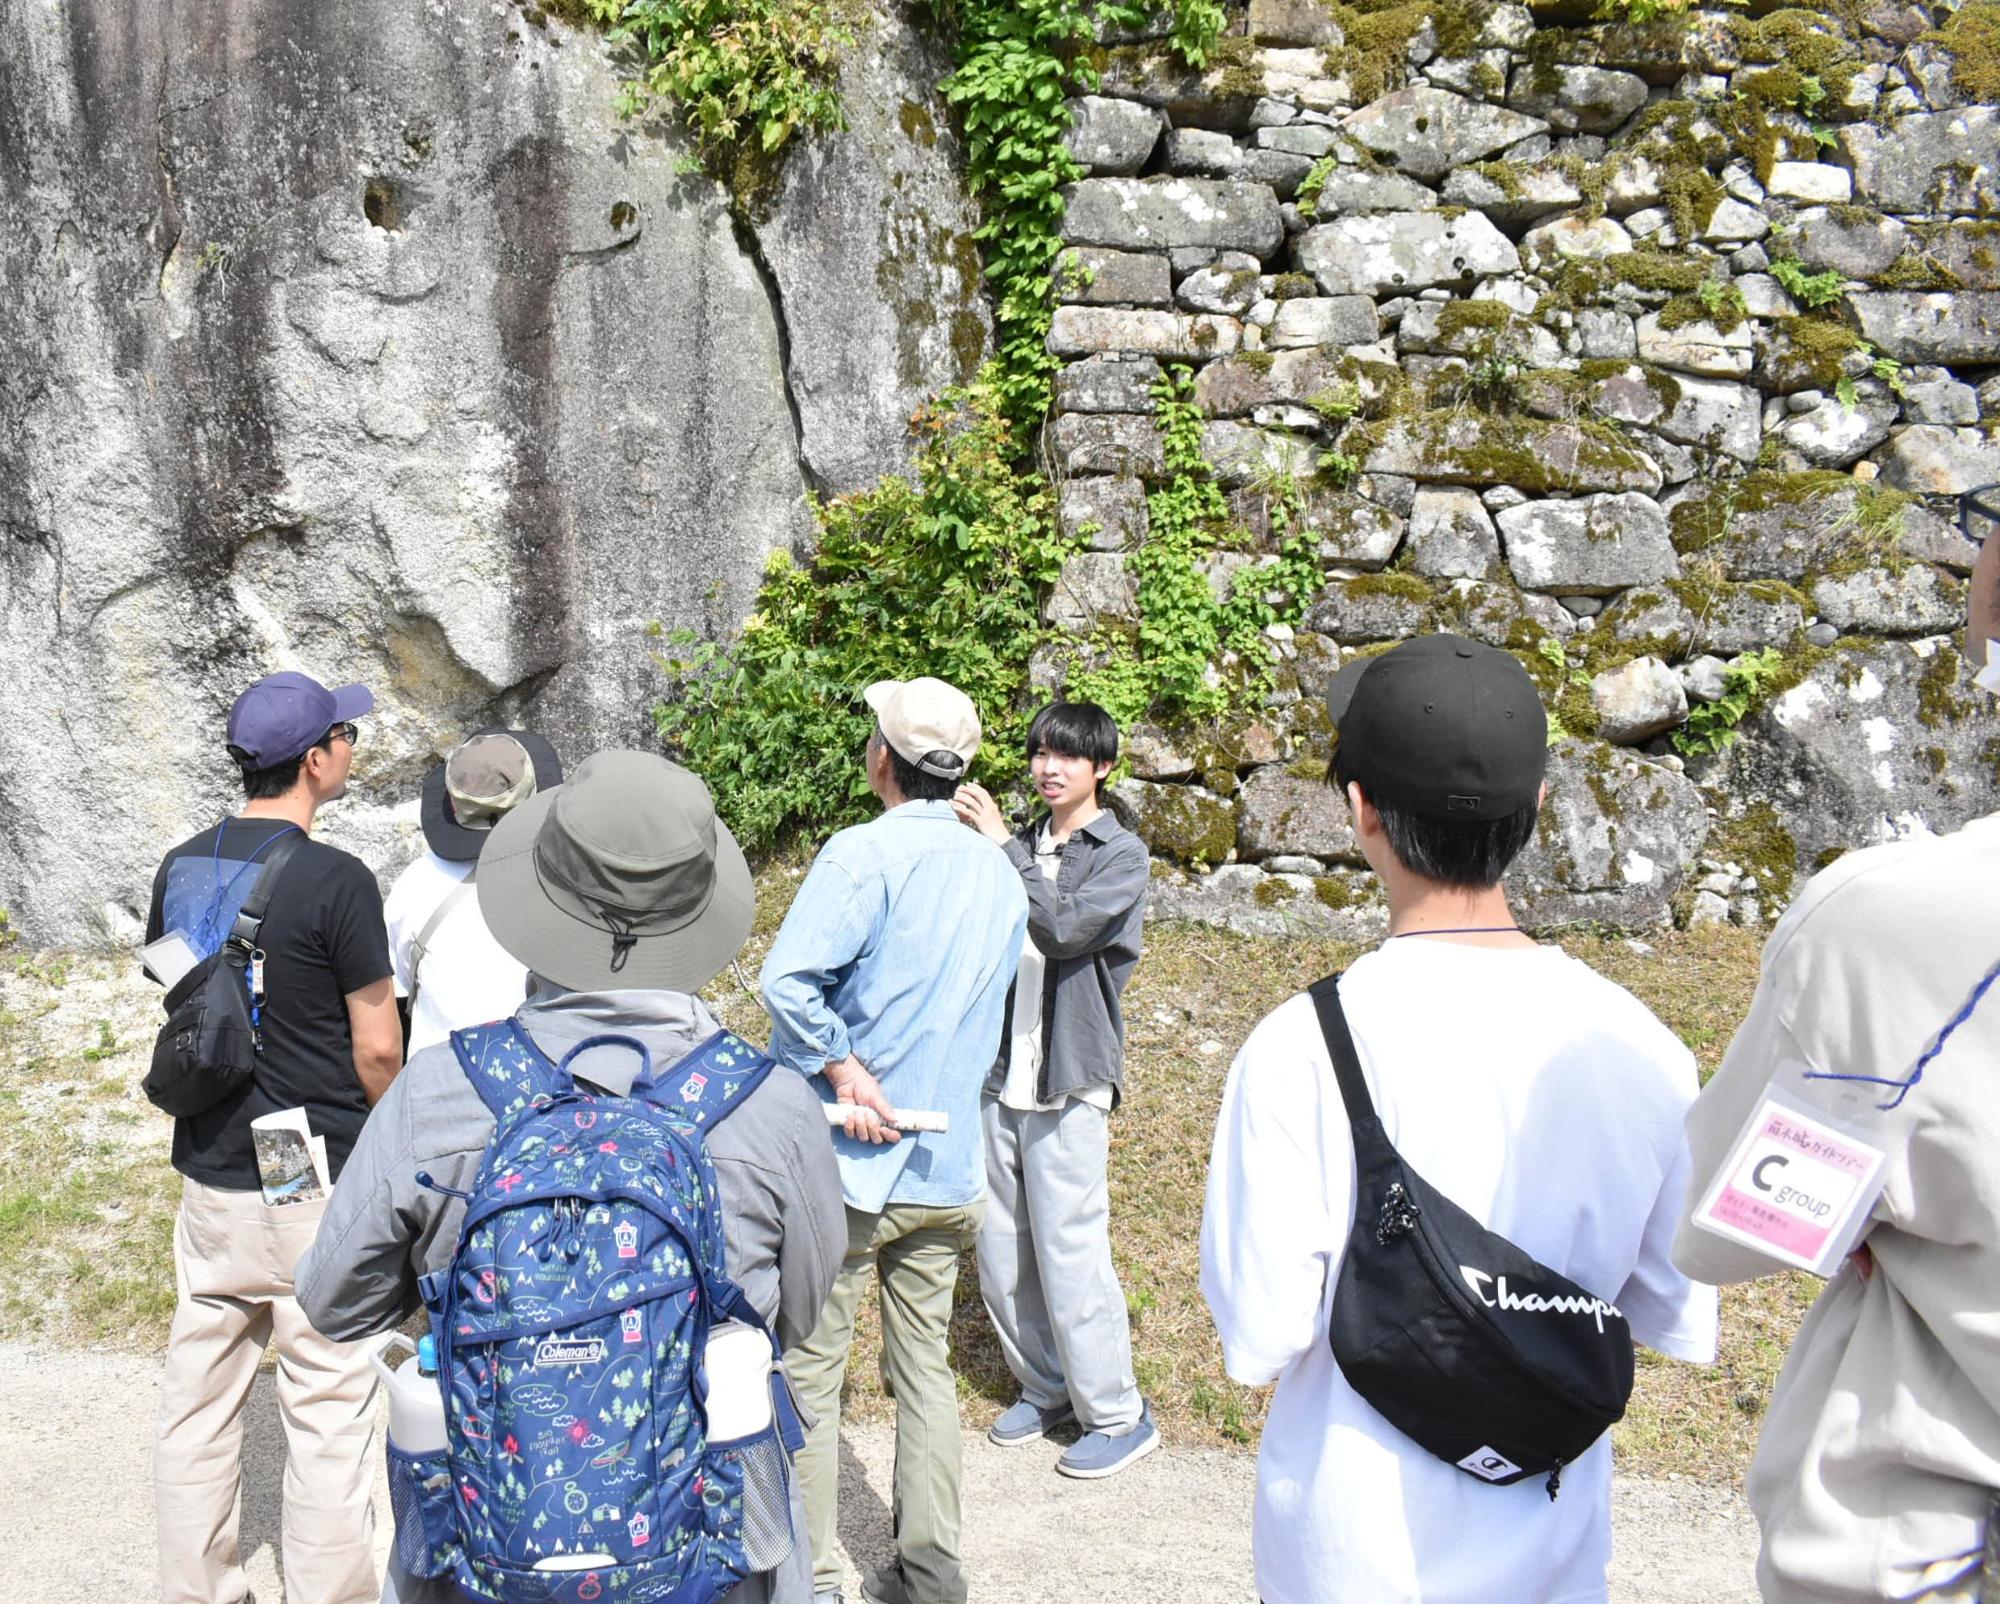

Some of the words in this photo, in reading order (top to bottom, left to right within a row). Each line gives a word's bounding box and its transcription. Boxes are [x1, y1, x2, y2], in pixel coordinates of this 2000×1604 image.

[1752, 1154, 1789, 1191] C
[1774, 1185, 1832, 1219] group
[541, 1344, 589, 1359] Coleman
